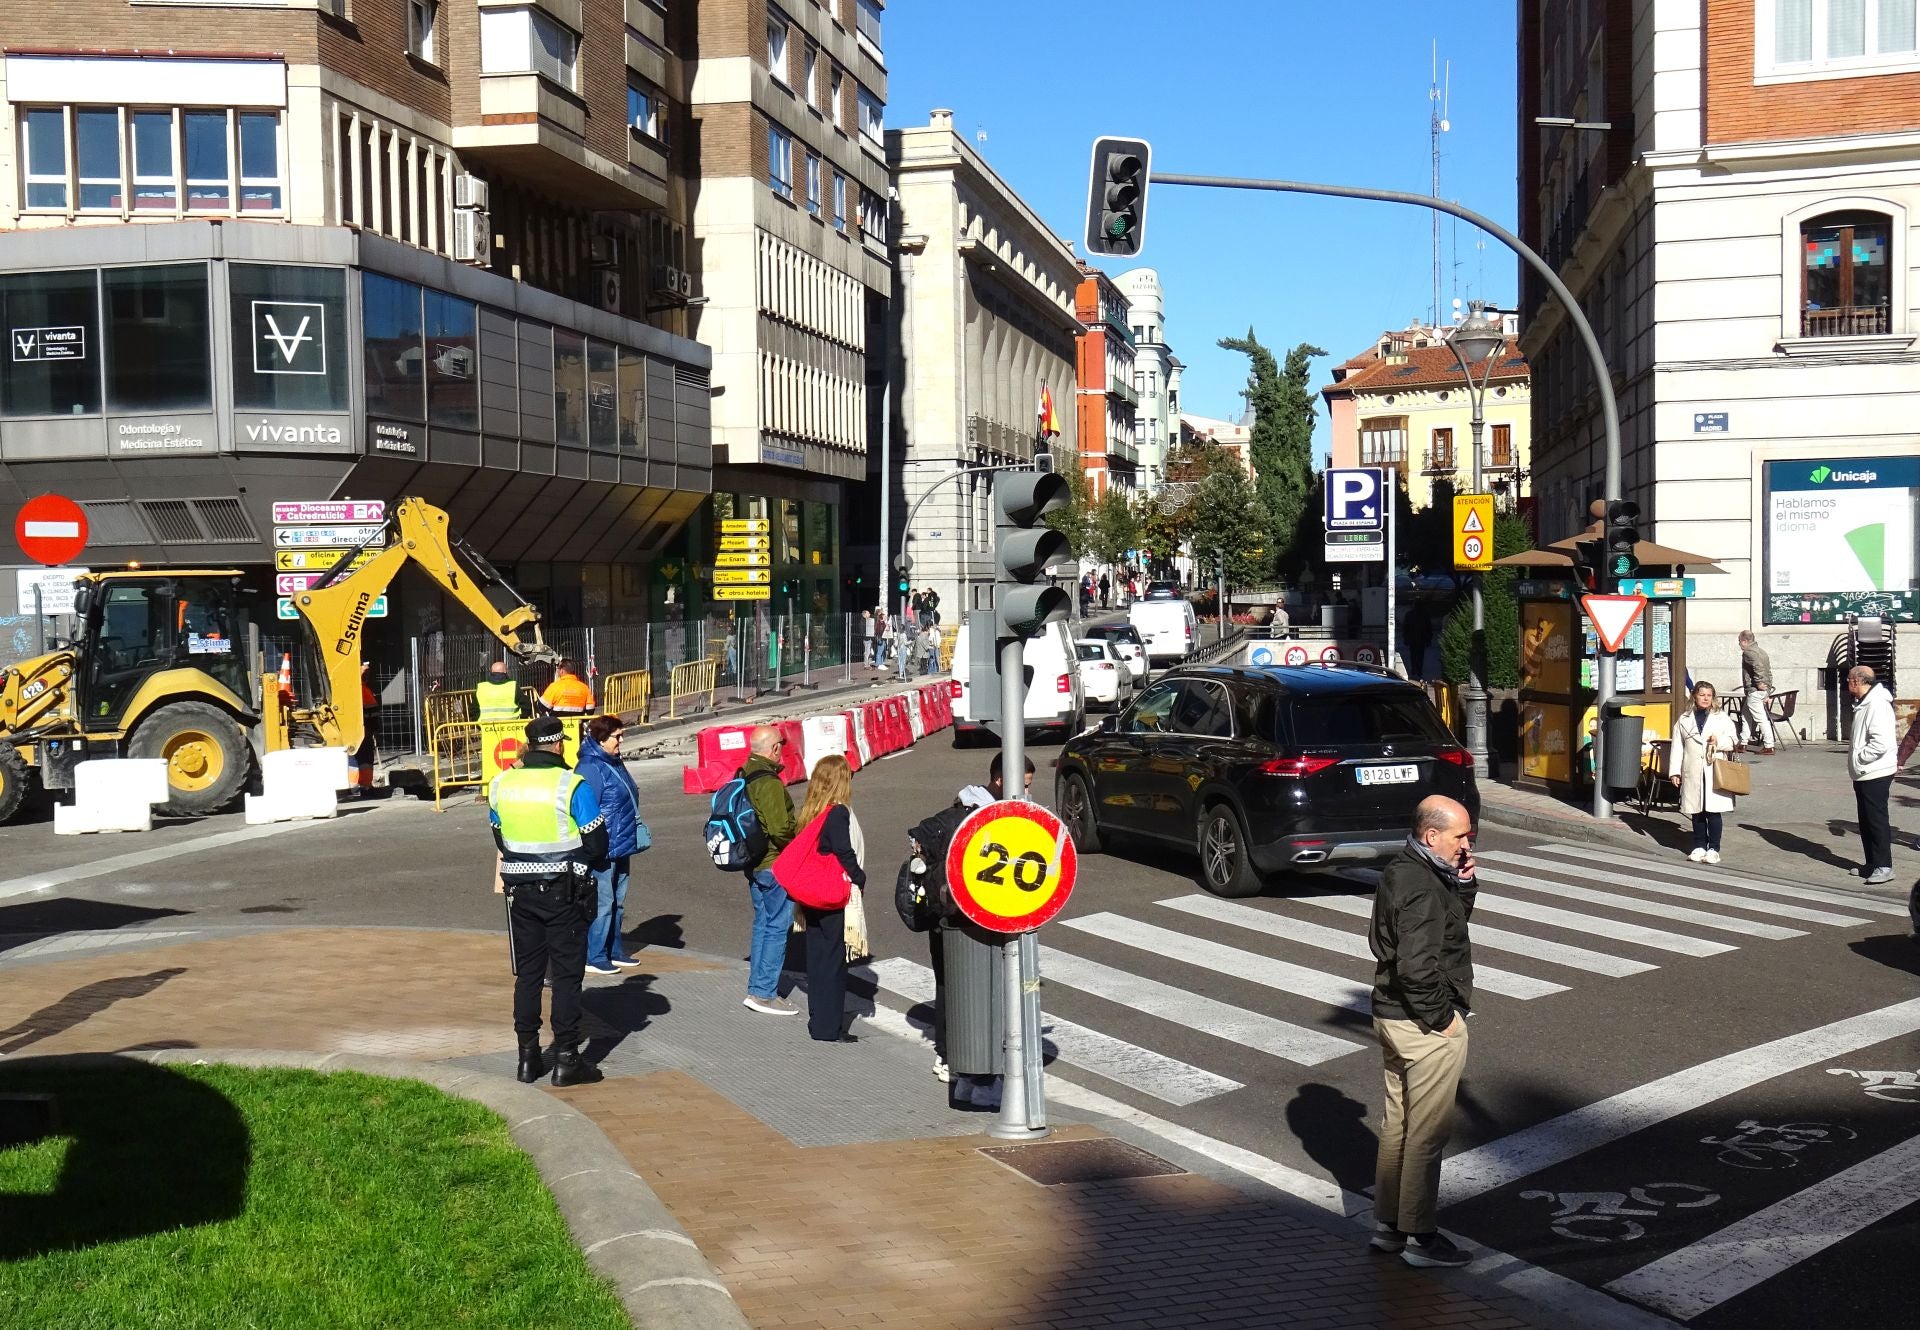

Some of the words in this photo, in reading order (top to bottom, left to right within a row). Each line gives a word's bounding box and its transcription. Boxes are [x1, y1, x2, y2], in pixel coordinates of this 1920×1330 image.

[45, 331, 77, 342] vivanta
[175, 424, 182, 435] y
[246, 419, 342, 444] vivanta
[120, 439, 163, 450] Medicina
[163, 438, 203, 449] Estética
[1831, 470, 1877, 484] Unicaja
[1332, 472, 1375, 519] P
[1457, 497, 1490, 505] ATENCIÓN
[300, 504, 347, 512] Diocesano
[1776, 498, 1837, 509] Hablamos
[1776, 510, 1787, 521] el
[1789, 511, 1830, 520] mismo
[358, 528, 376, 536] otra
[1776, 522, 1817, 532] idioma
[1344, 534, 1369, 542] LIBRE
[1467, 543, 1479, 553] 30
[1359, 653, 1372, 662] 20
[22, 680, 45, 701] 428
[1363, 768, 1391, 781] 8126
[1393, 767, 1413, 780] LWF
[975, 842, 1048, 893] 20
